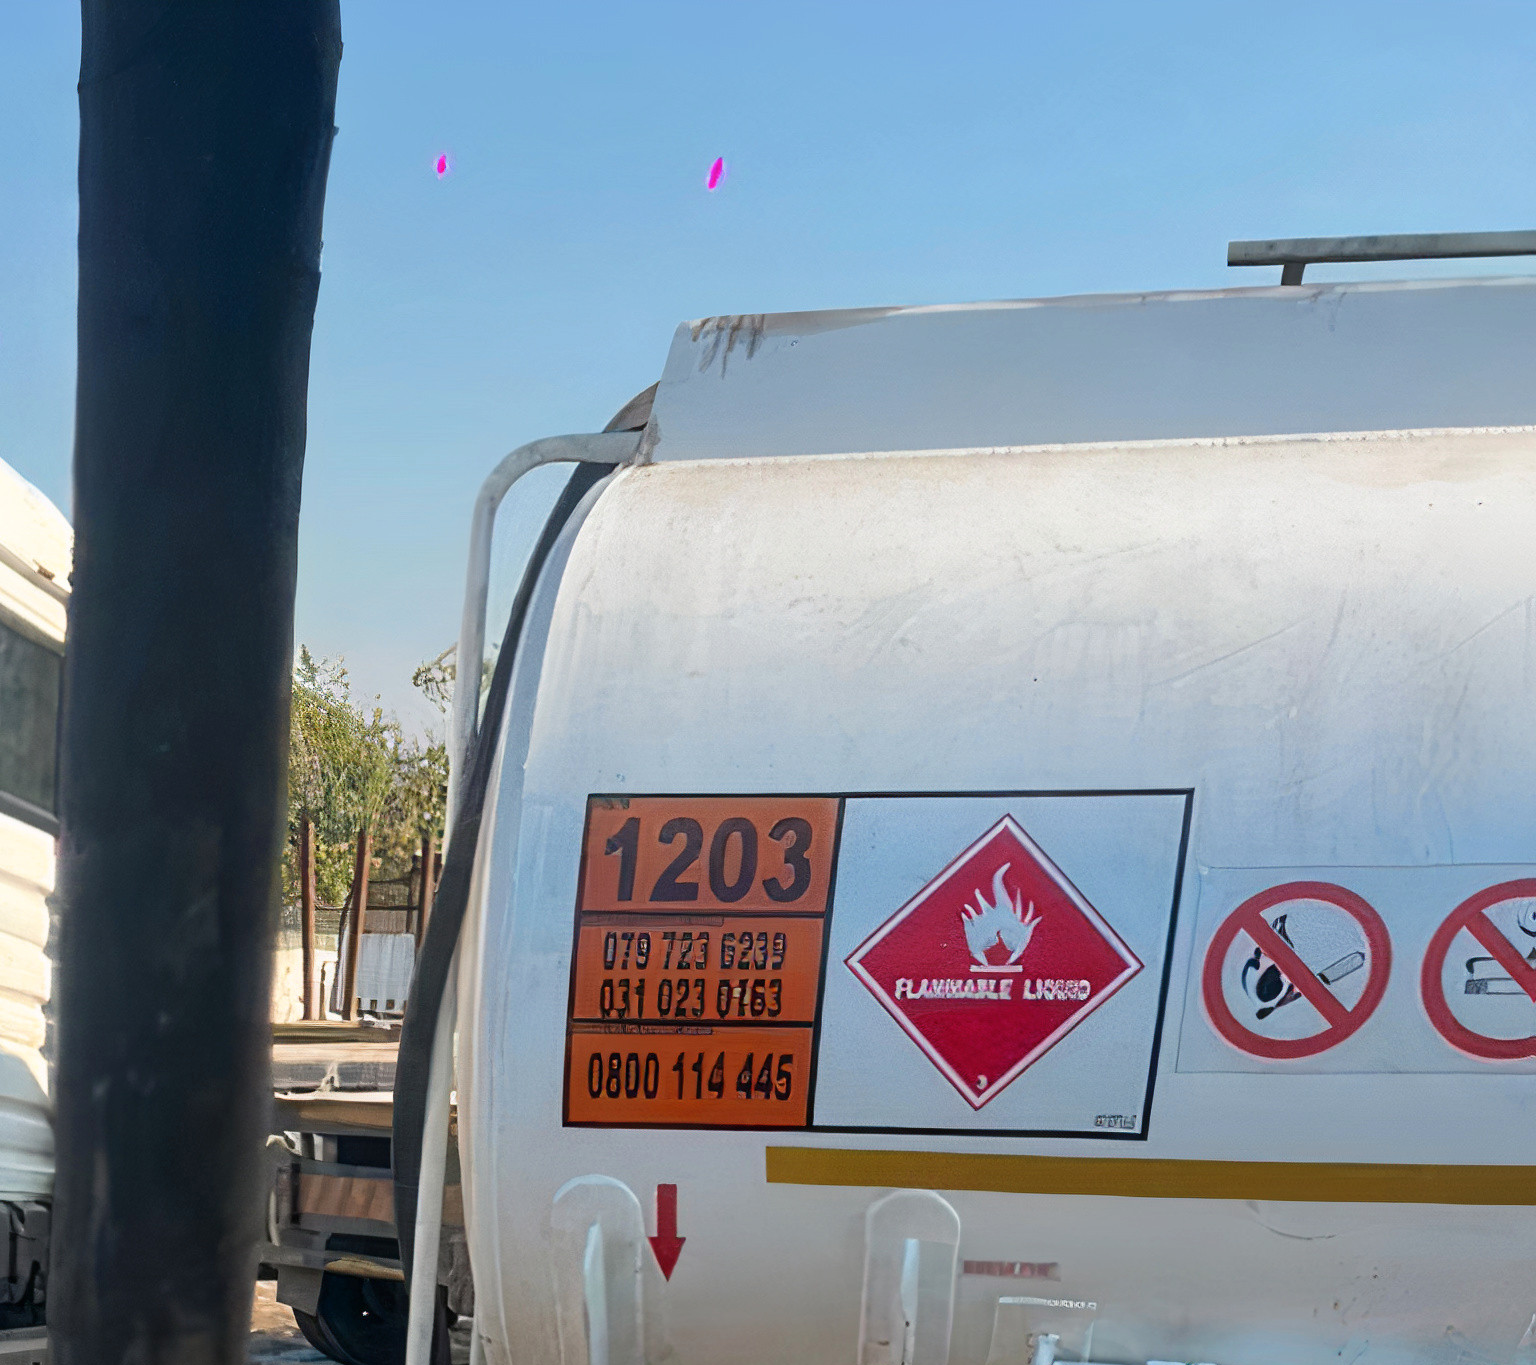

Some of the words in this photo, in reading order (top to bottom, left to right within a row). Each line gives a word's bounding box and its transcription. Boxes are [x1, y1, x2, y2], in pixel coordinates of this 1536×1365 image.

[604, 817, 812, 902] 1203
[657, 978, 705, 1018] 023
[588, 1052, 659, 1099] 0800
[672, 1051, 725, 1099] 114
[736, 1052, 793, 1100] 445
